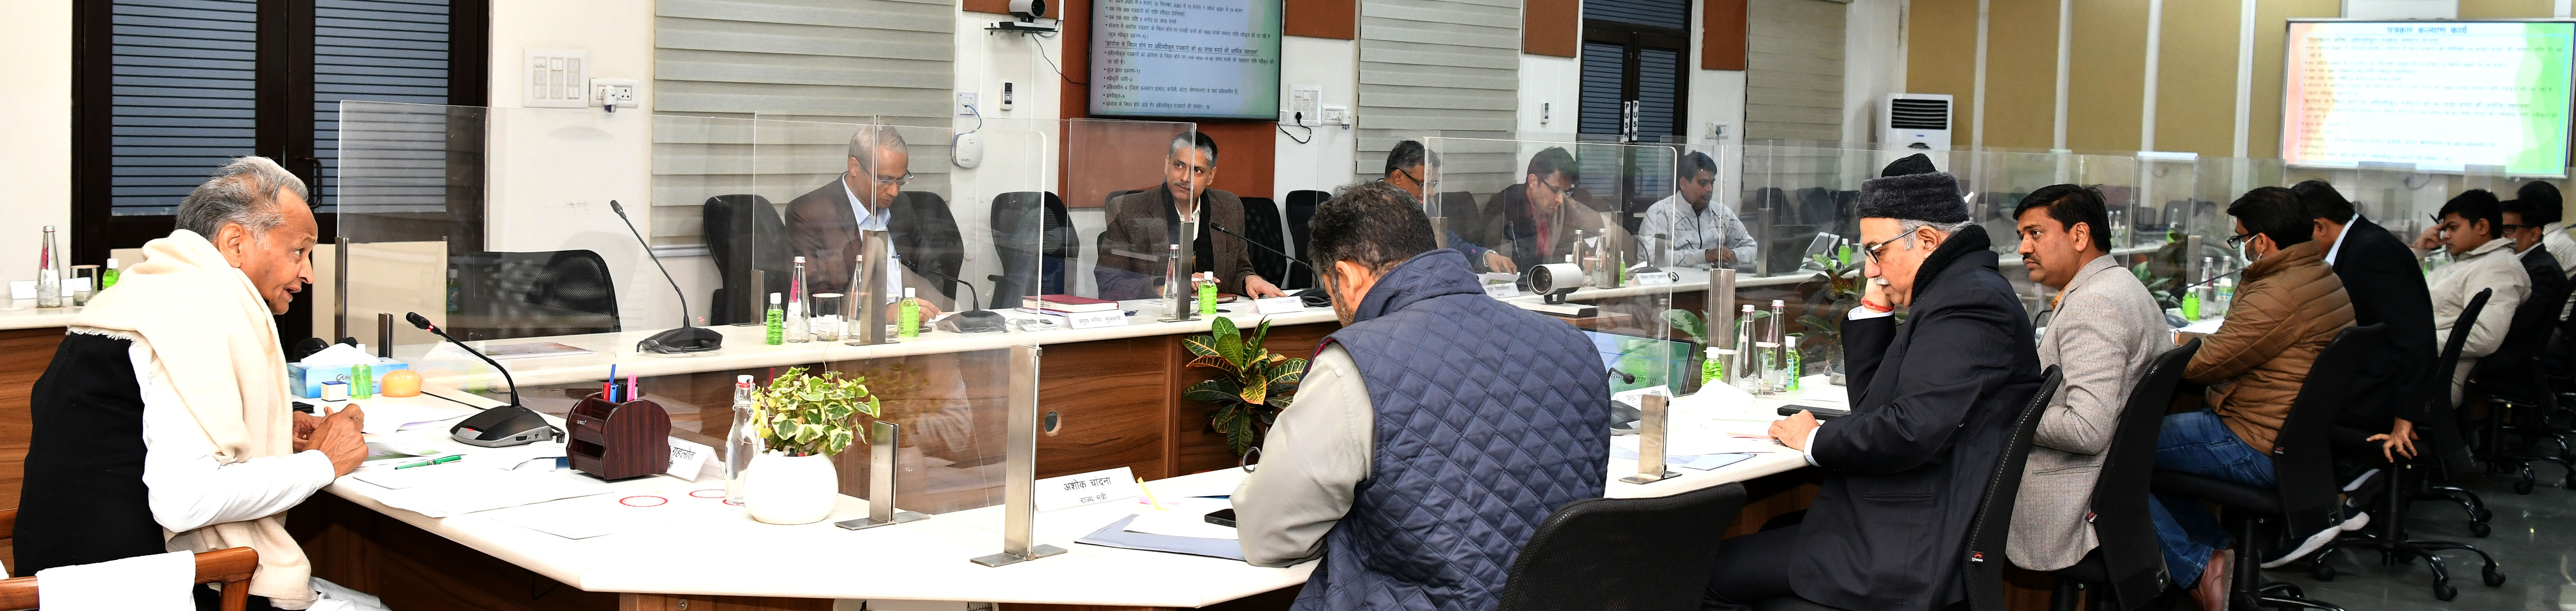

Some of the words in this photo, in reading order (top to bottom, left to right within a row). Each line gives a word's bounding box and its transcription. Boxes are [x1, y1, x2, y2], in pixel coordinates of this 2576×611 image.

[1155, 43, 1174, 51] अधिस्वीकृत
[1650, 377, 1656, 385] दी
[672, 446, 696, 460] गहलोत
[1064, 479, 1086, 491] अशोक
[1090, 476, 1111, 487] चांदना
